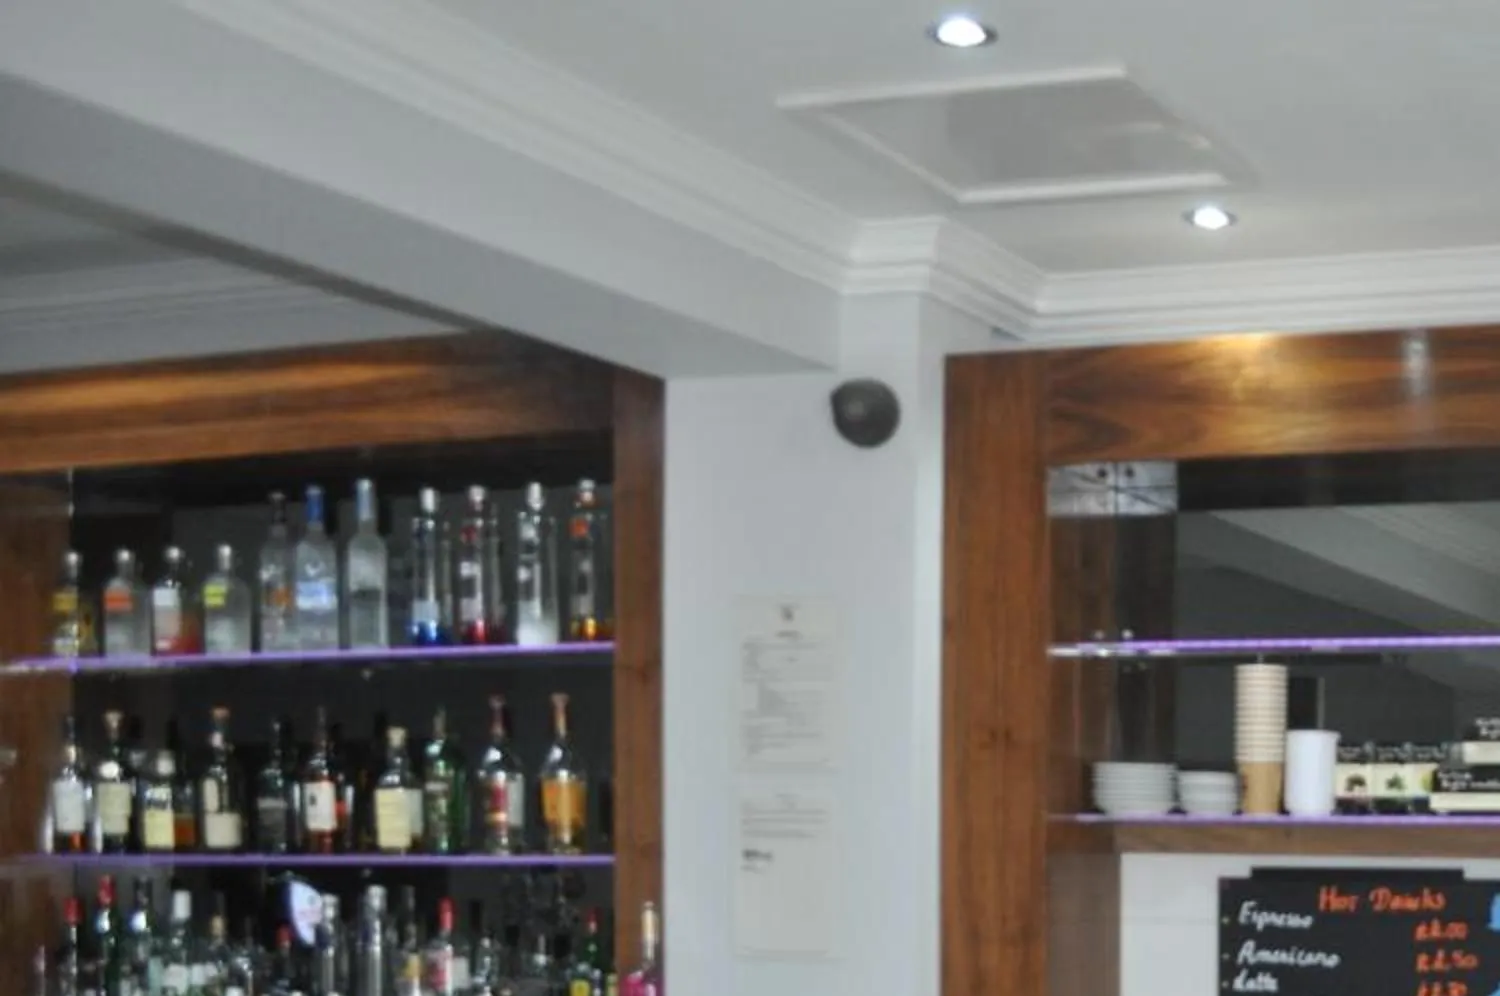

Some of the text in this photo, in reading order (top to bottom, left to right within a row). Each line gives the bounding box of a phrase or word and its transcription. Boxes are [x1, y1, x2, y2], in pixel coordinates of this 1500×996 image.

[1239, 900, 1313, 932] Espresso
[1237, 939, 1341, 968] Americano
[1232, 968, 1278, 992] Latte
